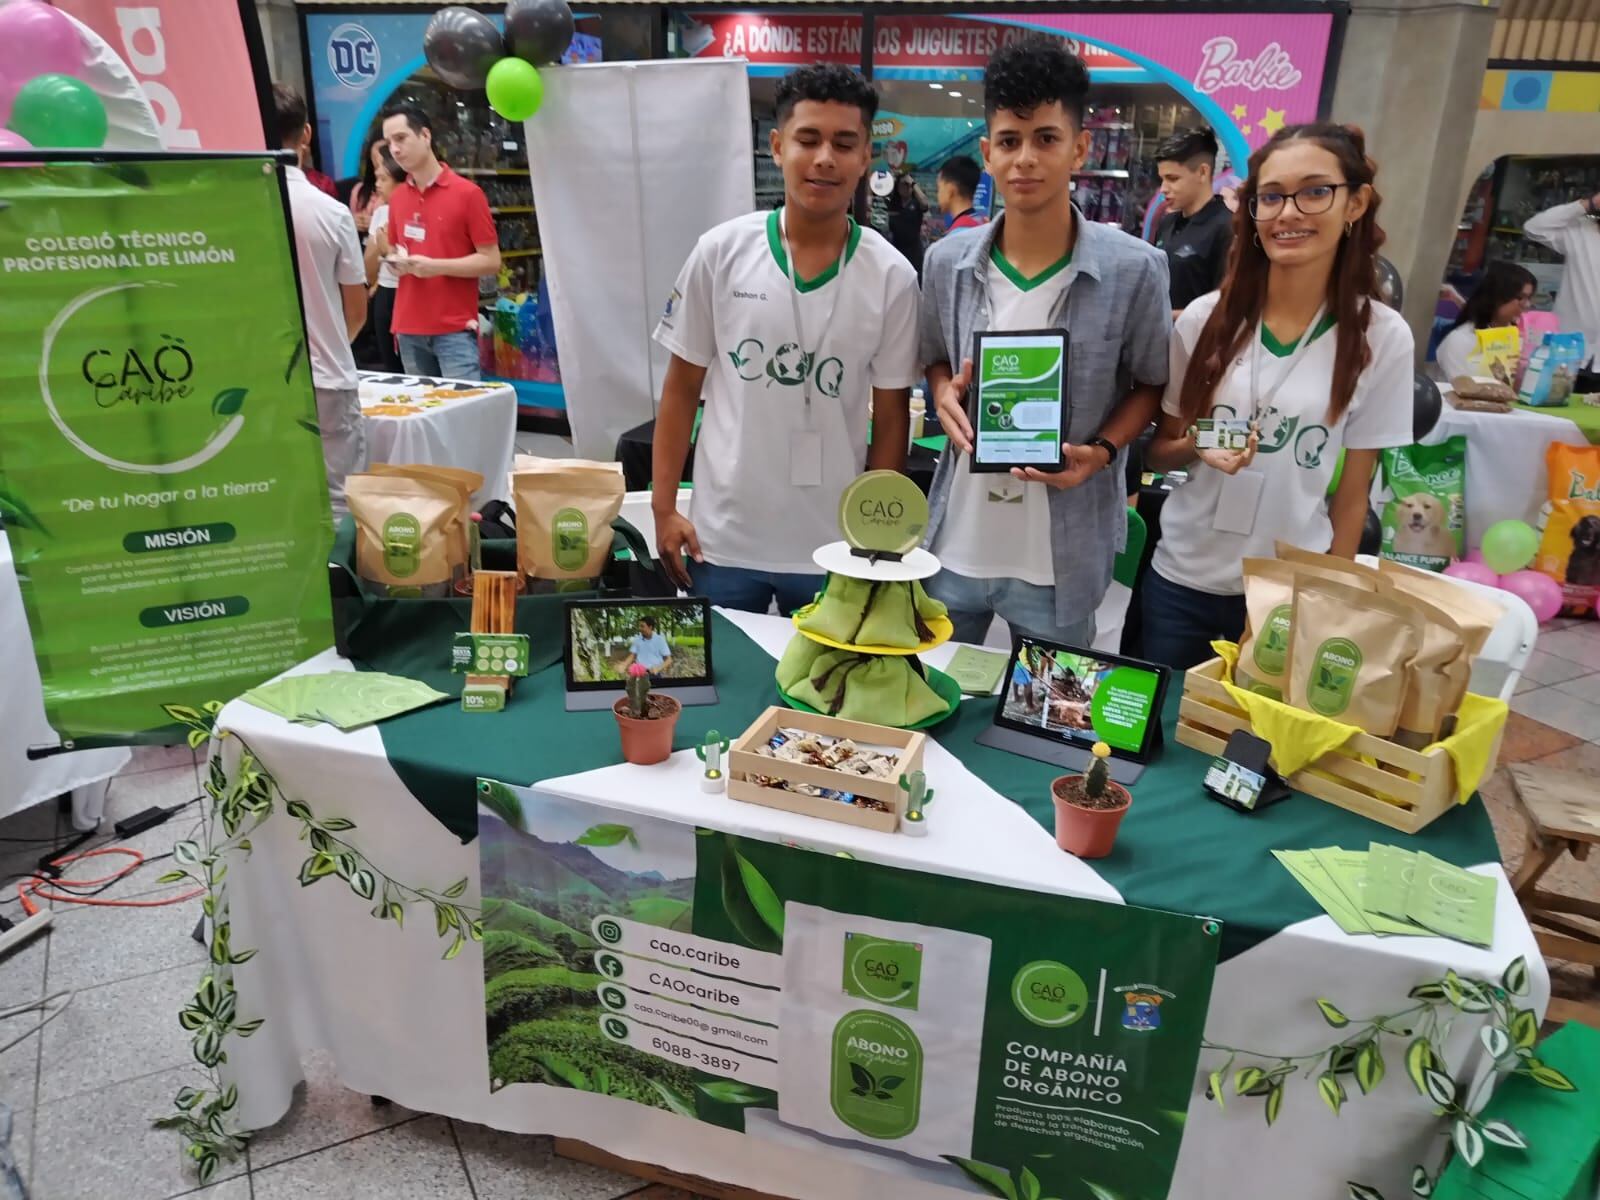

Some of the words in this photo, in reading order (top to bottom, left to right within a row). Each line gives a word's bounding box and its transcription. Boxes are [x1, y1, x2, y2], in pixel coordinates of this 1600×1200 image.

[750, 18, 803, 53] DÓNDE
[807, 21, 863, 54] ESTÁN
[905, 27, 998, 56] JUGUETES
[331, 39, 376, 75] DC
[1193, 36, 1302, 93] Barbie
[119, 230, 207, 248] TÉCNICO
[3, 254, 141, 272] PROFESIONAL
[145, 251, 170, 265] DE
[174, 246, 235, 264] LIMÓN
[95, 370, 194, 408] Caribe
[100, 495, 119, 508] tu
[124, 489, 179, 509] hogar
[184, 488, 196, 500] a
[202, 483, 218, 499] la
[144, 527, 211, 549] MISIÓN
[163, 601, 227, 623] VISIÓN
[1322, 651, 1356, 667] ABONO
[465, 695, 484, 705] 10%
[649, 938, 741, 969] cao.caribe
[649, 973, 741, 1006] CAOcaribe
[847, 1035, 909, 1058] ABONO
[1006, 1041, 1128, 1073] COMPAÑÍA
[1004, 1058, 1032, 1076] DE
[1039, 1066, 1120, 1088] ABONO
[1003, 1075, 1123, 1104] ORGÁNICO
[993, 1119, 1008, 1128] de
[1010, 1120, 1062, 1137] desechos
[995, 1104, 1043, 1119] Producto
[1046, 1113, 1071, 1122] 100%
[1074, 1116, 1130, 1136] elaborado
[995, 1112, 1046, 1127] mediante
[1048, 1121, 1059, 1130] la
[1062, 1122, 1145, 1150] transformación
